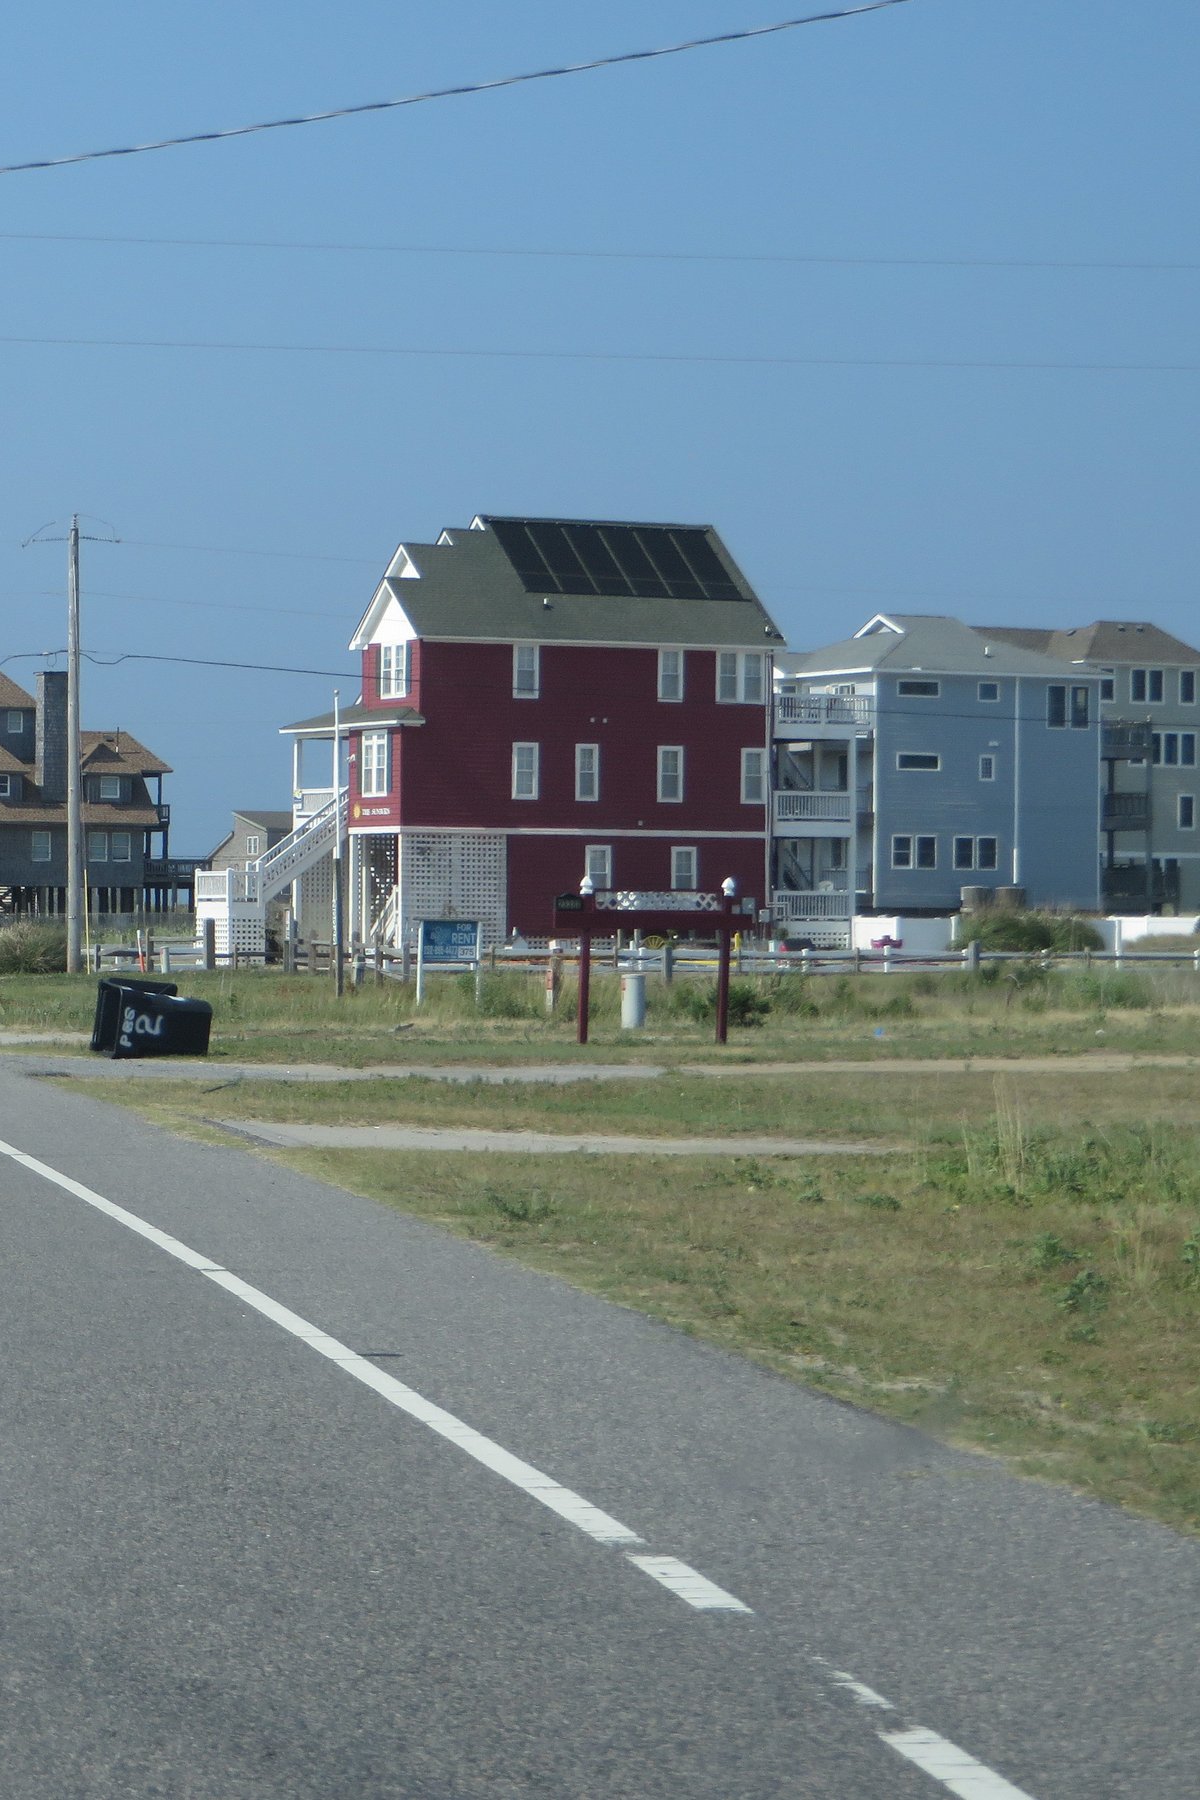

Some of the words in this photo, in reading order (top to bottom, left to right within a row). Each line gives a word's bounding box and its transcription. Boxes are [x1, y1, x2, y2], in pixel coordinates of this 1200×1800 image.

[456, 923, 472, 931] FOR
[451, 932, 476, 944] RENT
[135, 1014, 163, 1035] 2
